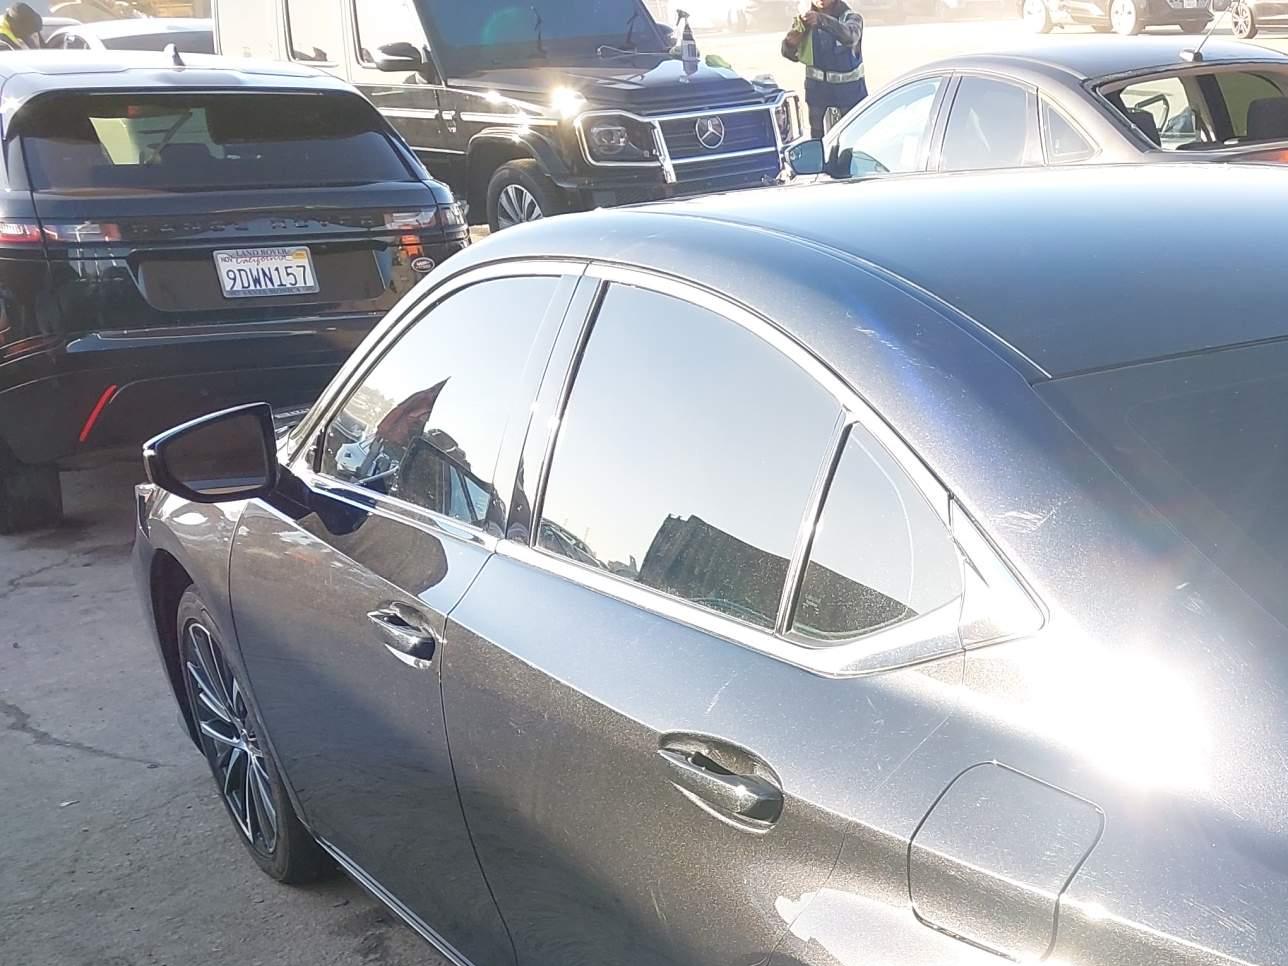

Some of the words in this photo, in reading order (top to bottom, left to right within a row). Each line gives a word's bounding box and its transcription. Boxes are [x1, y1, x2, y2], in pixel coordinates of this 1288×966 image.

[235, 249, 259, 257] LAND
[260, 247, 288, 256] ROVER
[235, 254, 288, 266] California
[226, 264, 308, 290] 9DWN157
